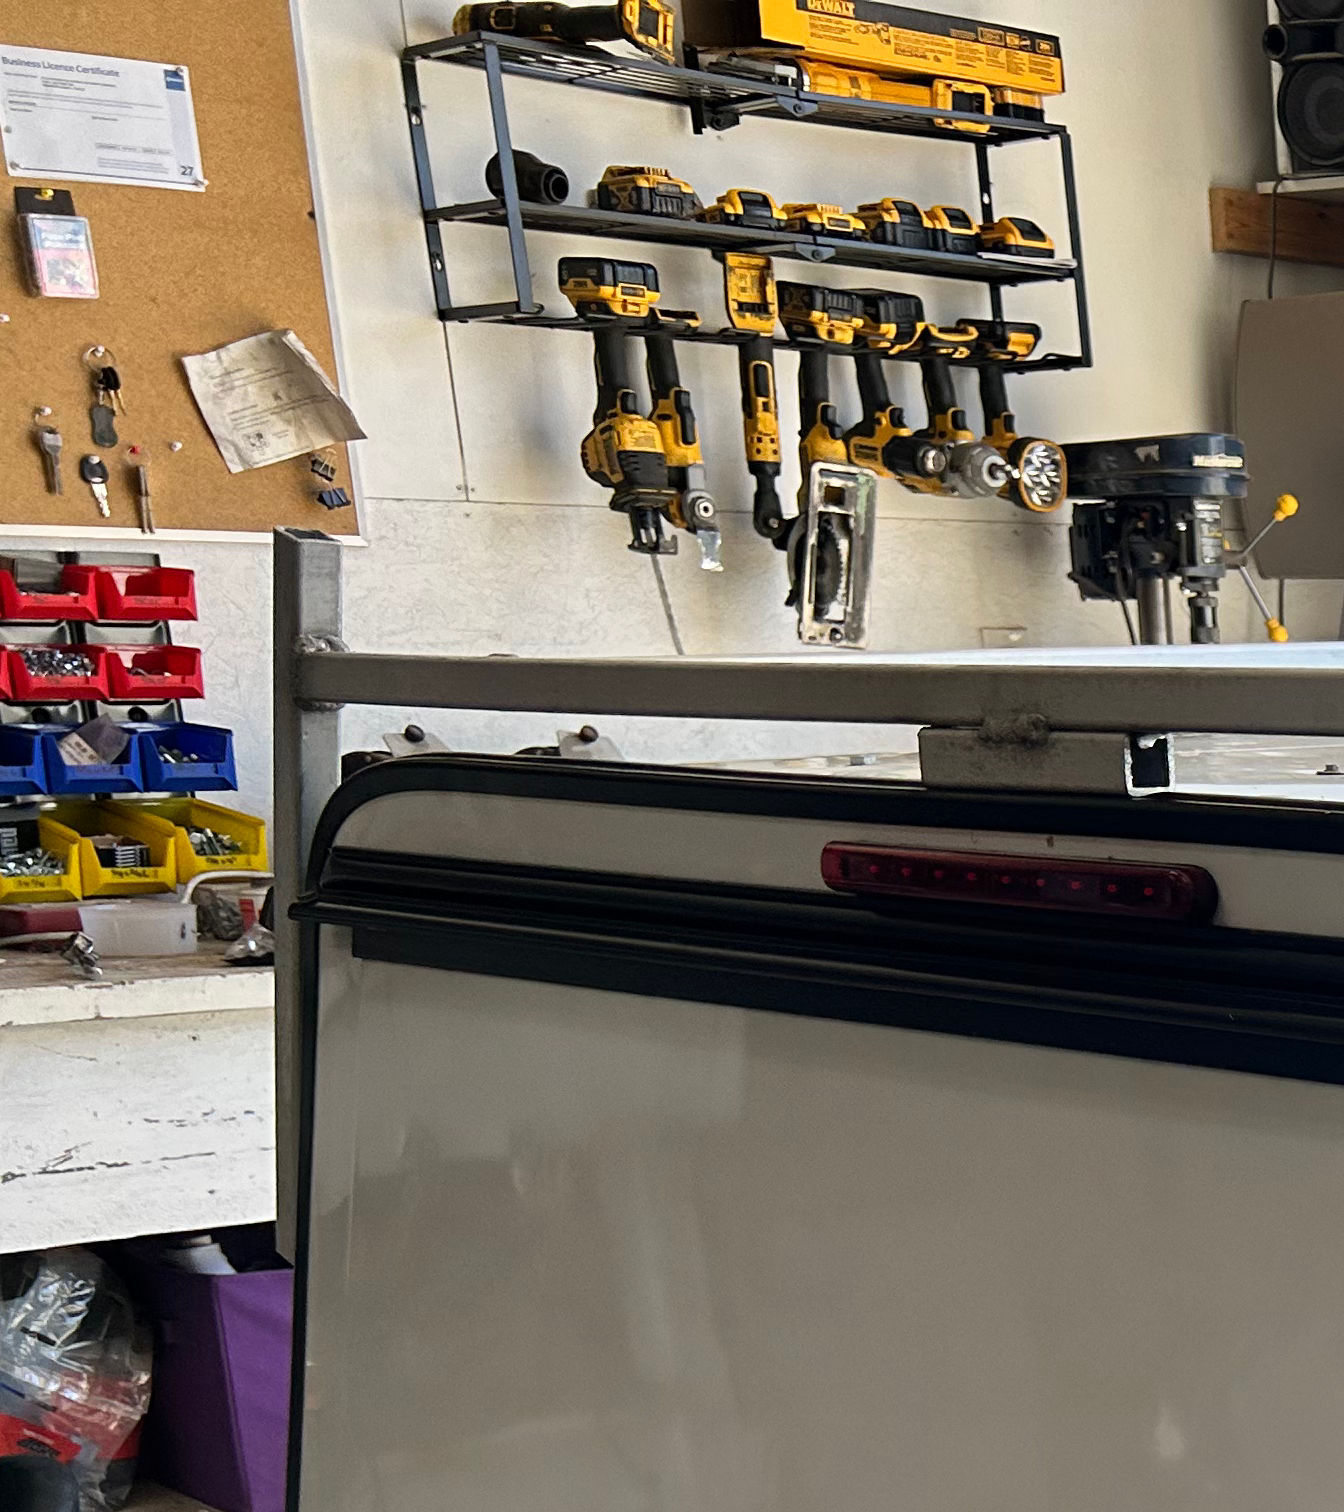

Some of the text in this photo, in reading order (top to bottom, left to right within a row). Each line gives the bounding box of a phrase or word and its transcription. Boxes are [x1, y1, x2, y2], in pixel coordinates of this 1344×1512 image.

[2, 56, 120, 78] Business Licence Certificate
[180, 166, 194, 176] 27
